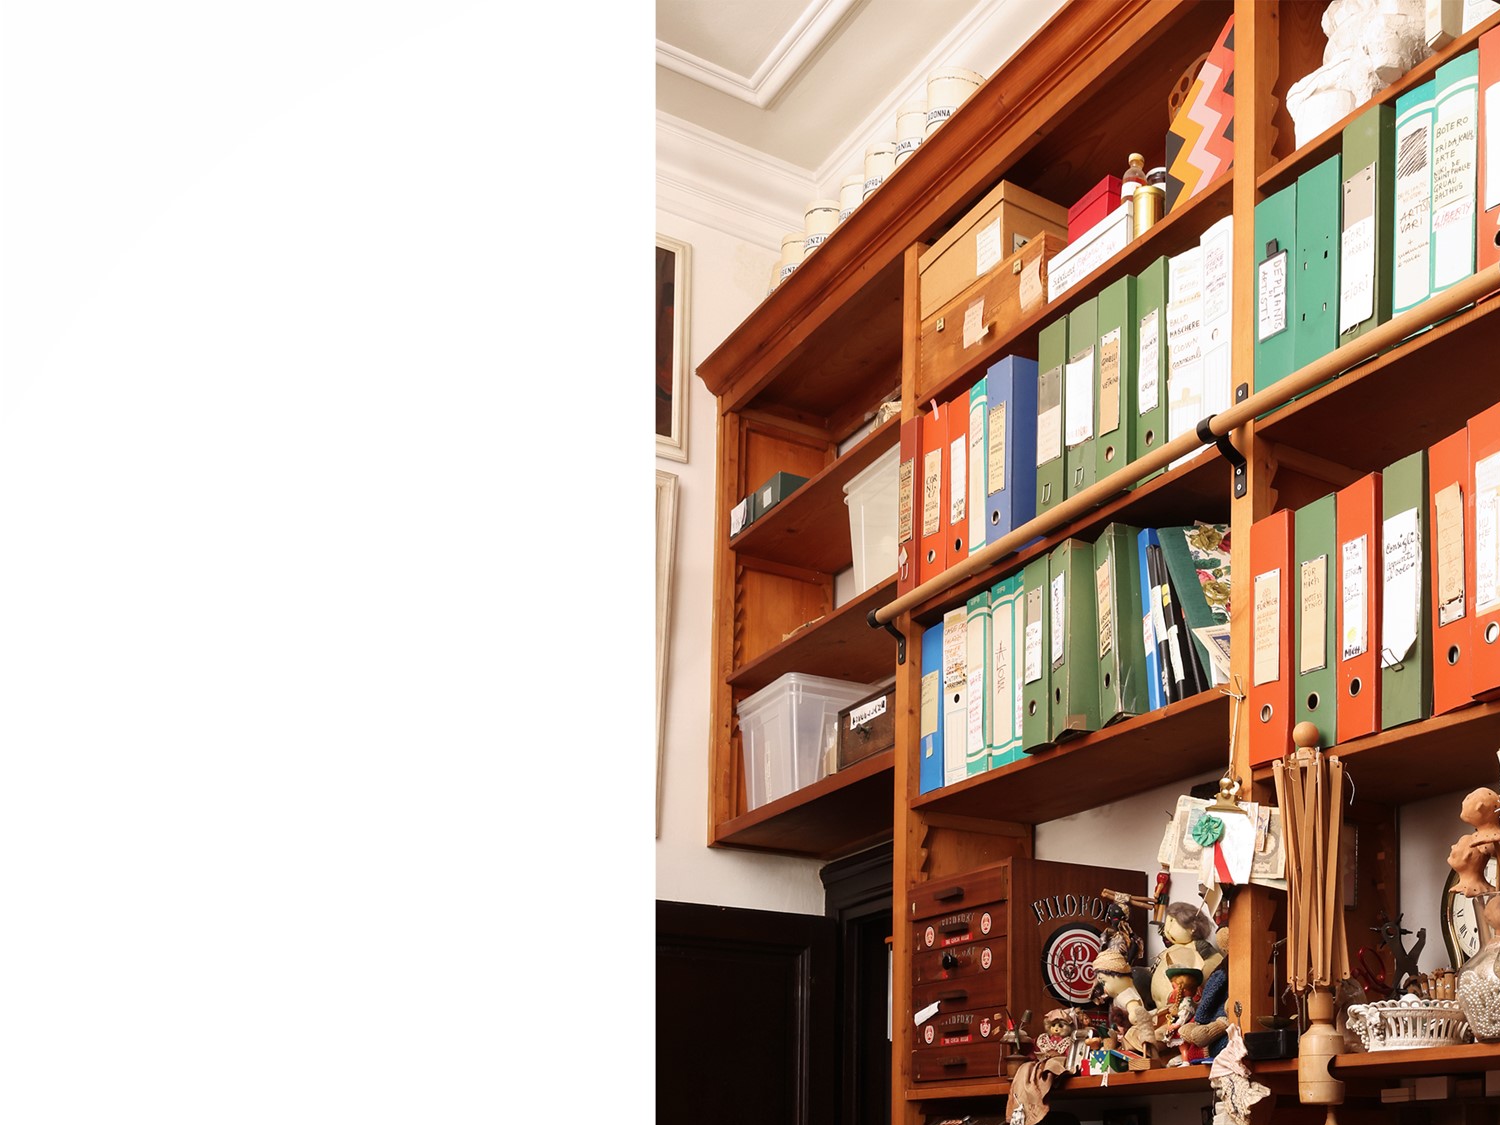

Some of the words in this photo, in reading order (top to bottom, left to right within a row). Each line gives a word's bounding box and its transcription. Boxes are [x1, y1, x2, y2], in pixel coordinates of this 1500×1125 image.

[1435, 116, 1469, 139] BOTERO
[1169, 319, 1201, 339] MASCHERE
[1030, 893, 1111, 926] FILOFO
